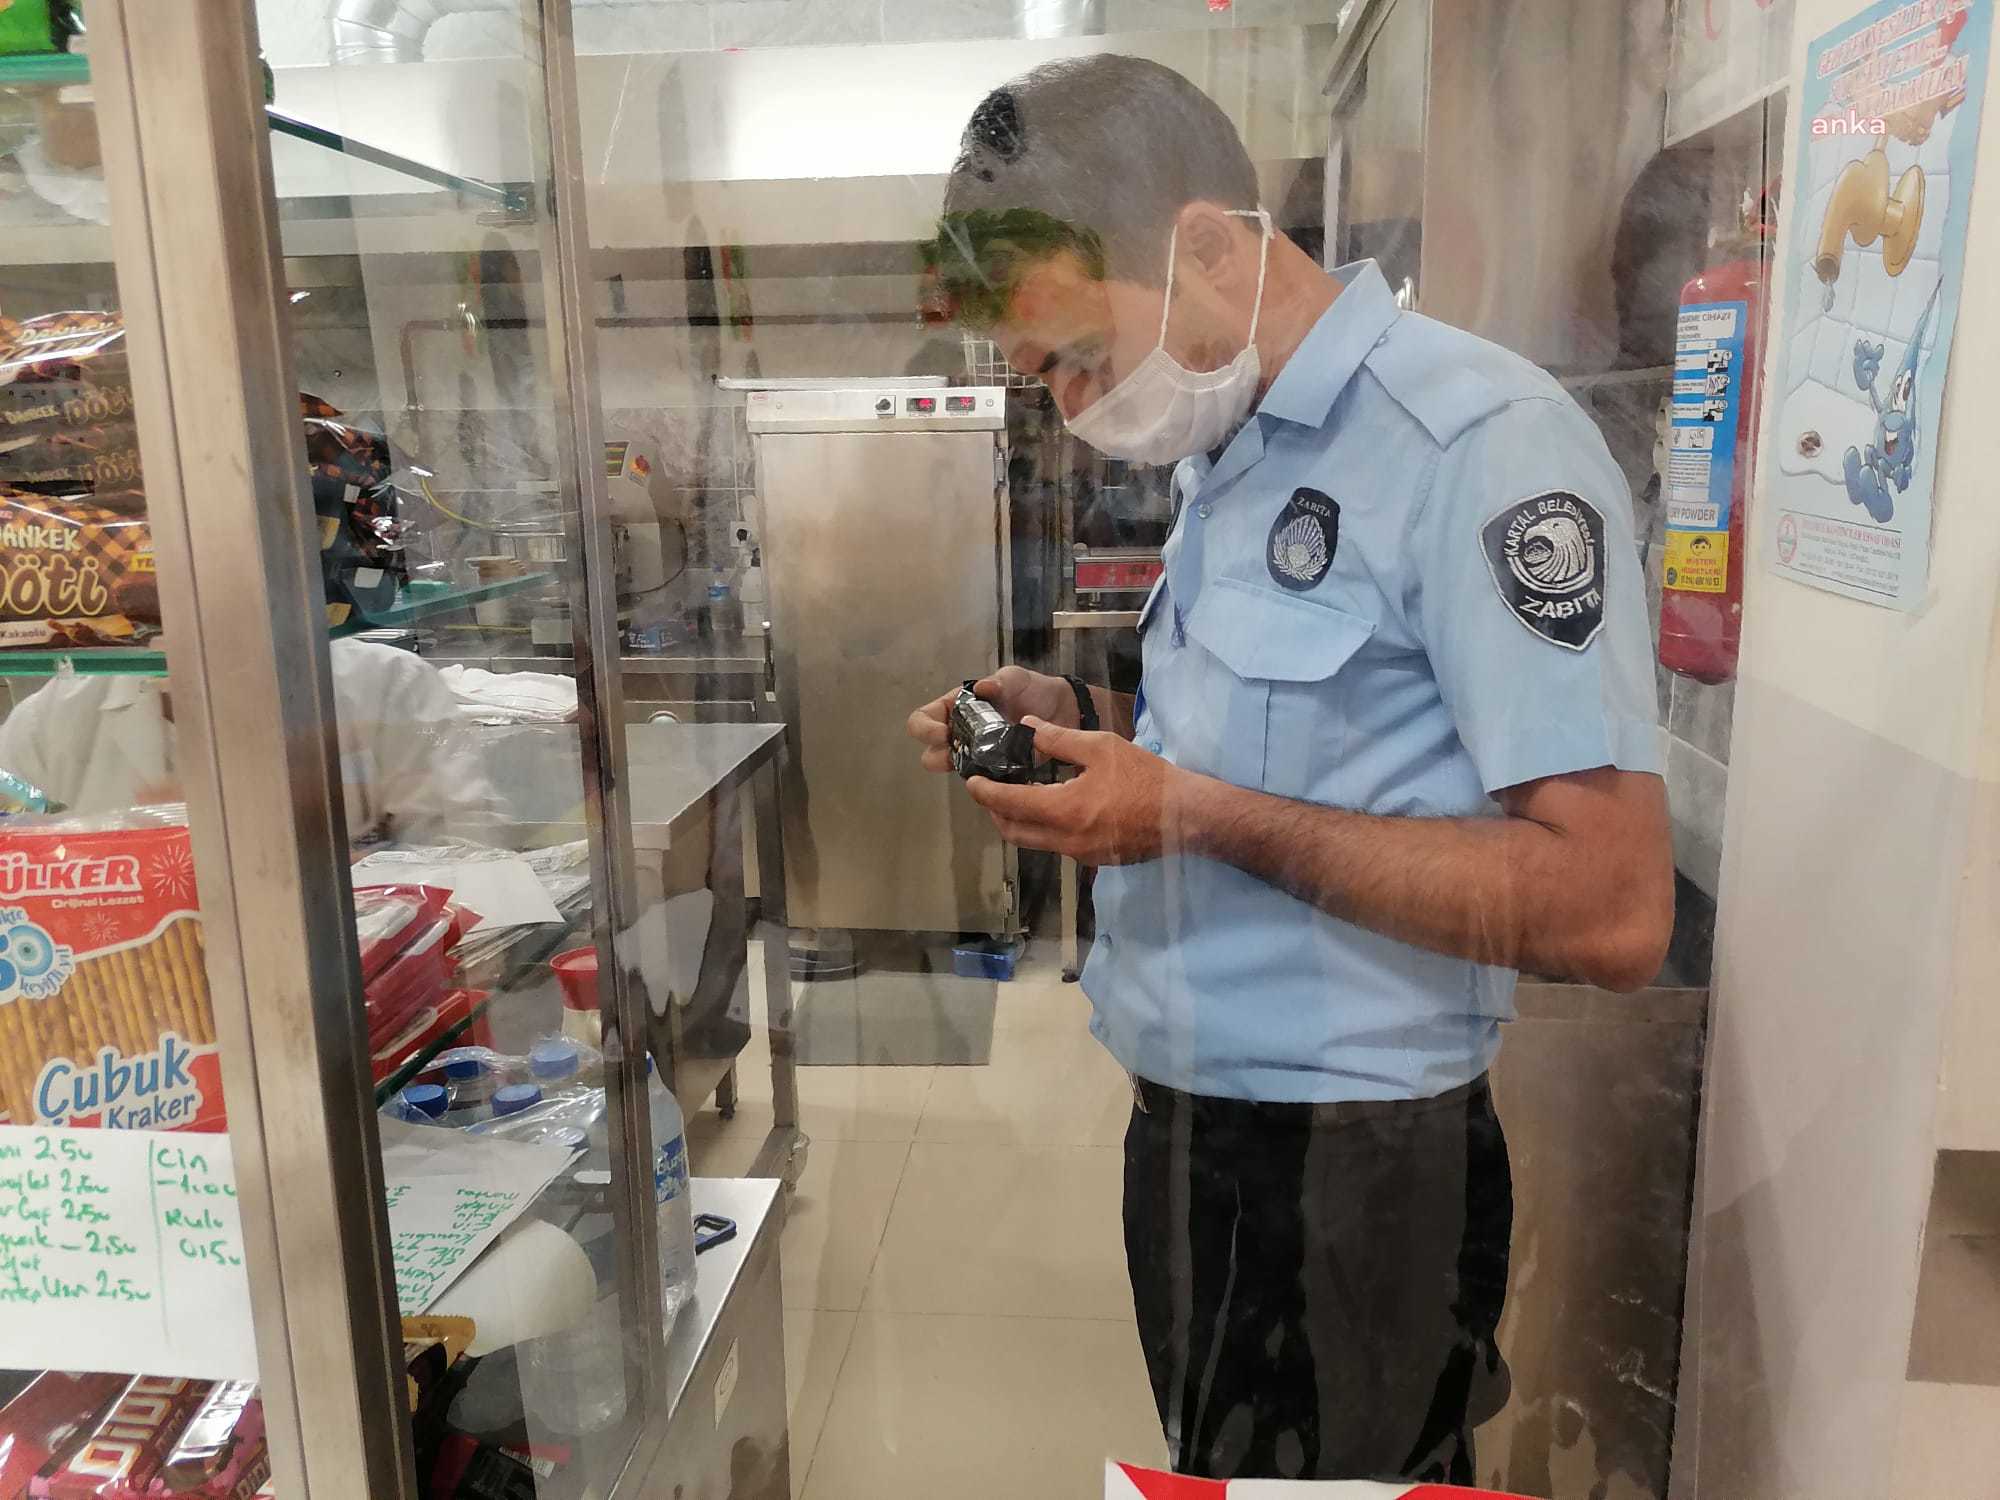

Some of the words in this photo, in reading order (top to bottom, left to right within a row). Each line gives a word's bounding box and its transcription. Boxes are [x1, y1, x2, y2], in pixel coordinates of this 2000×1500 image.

[0, 522, 81, 551] ANKEK
[1503, 509, 1537, 558] KARTAL
[0, 852, 142, 900] ÜLKER
[39, 1038, 190, 1125] Çubuk
[108, 1094, 196, 1130] Kraker
